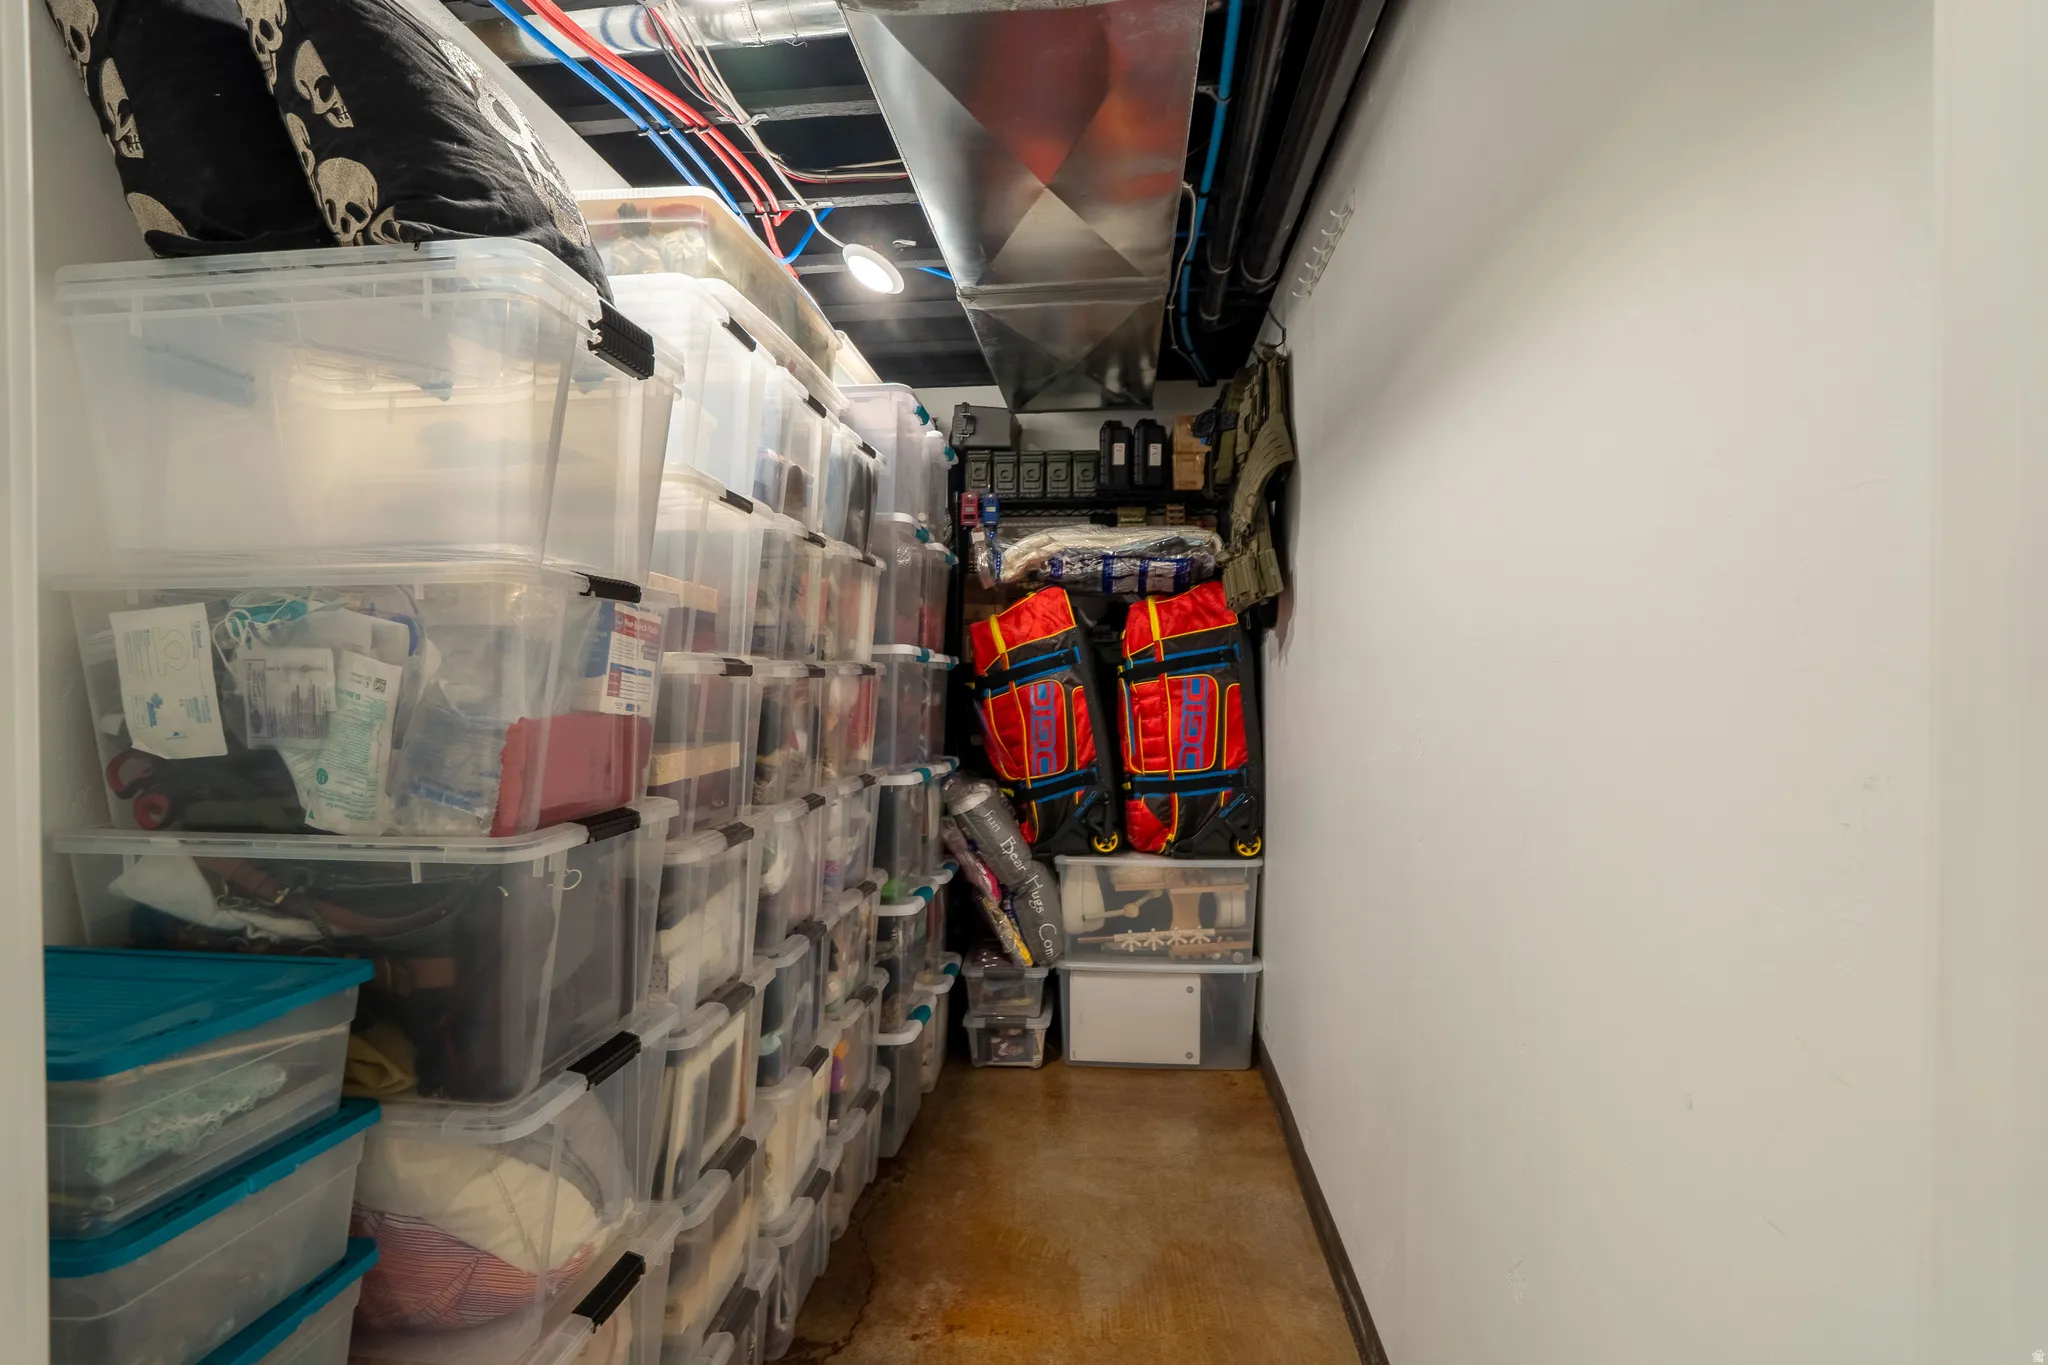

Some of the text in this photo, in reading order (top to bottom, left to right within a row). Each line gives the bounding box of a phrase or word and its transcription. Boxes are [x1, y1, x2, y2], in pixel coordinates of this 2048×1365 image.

[624, 618, 647, 633] Non-Sck
[999, 835, 1027, 872] Bear
[1025, 874, 1045, 914] Hugs
